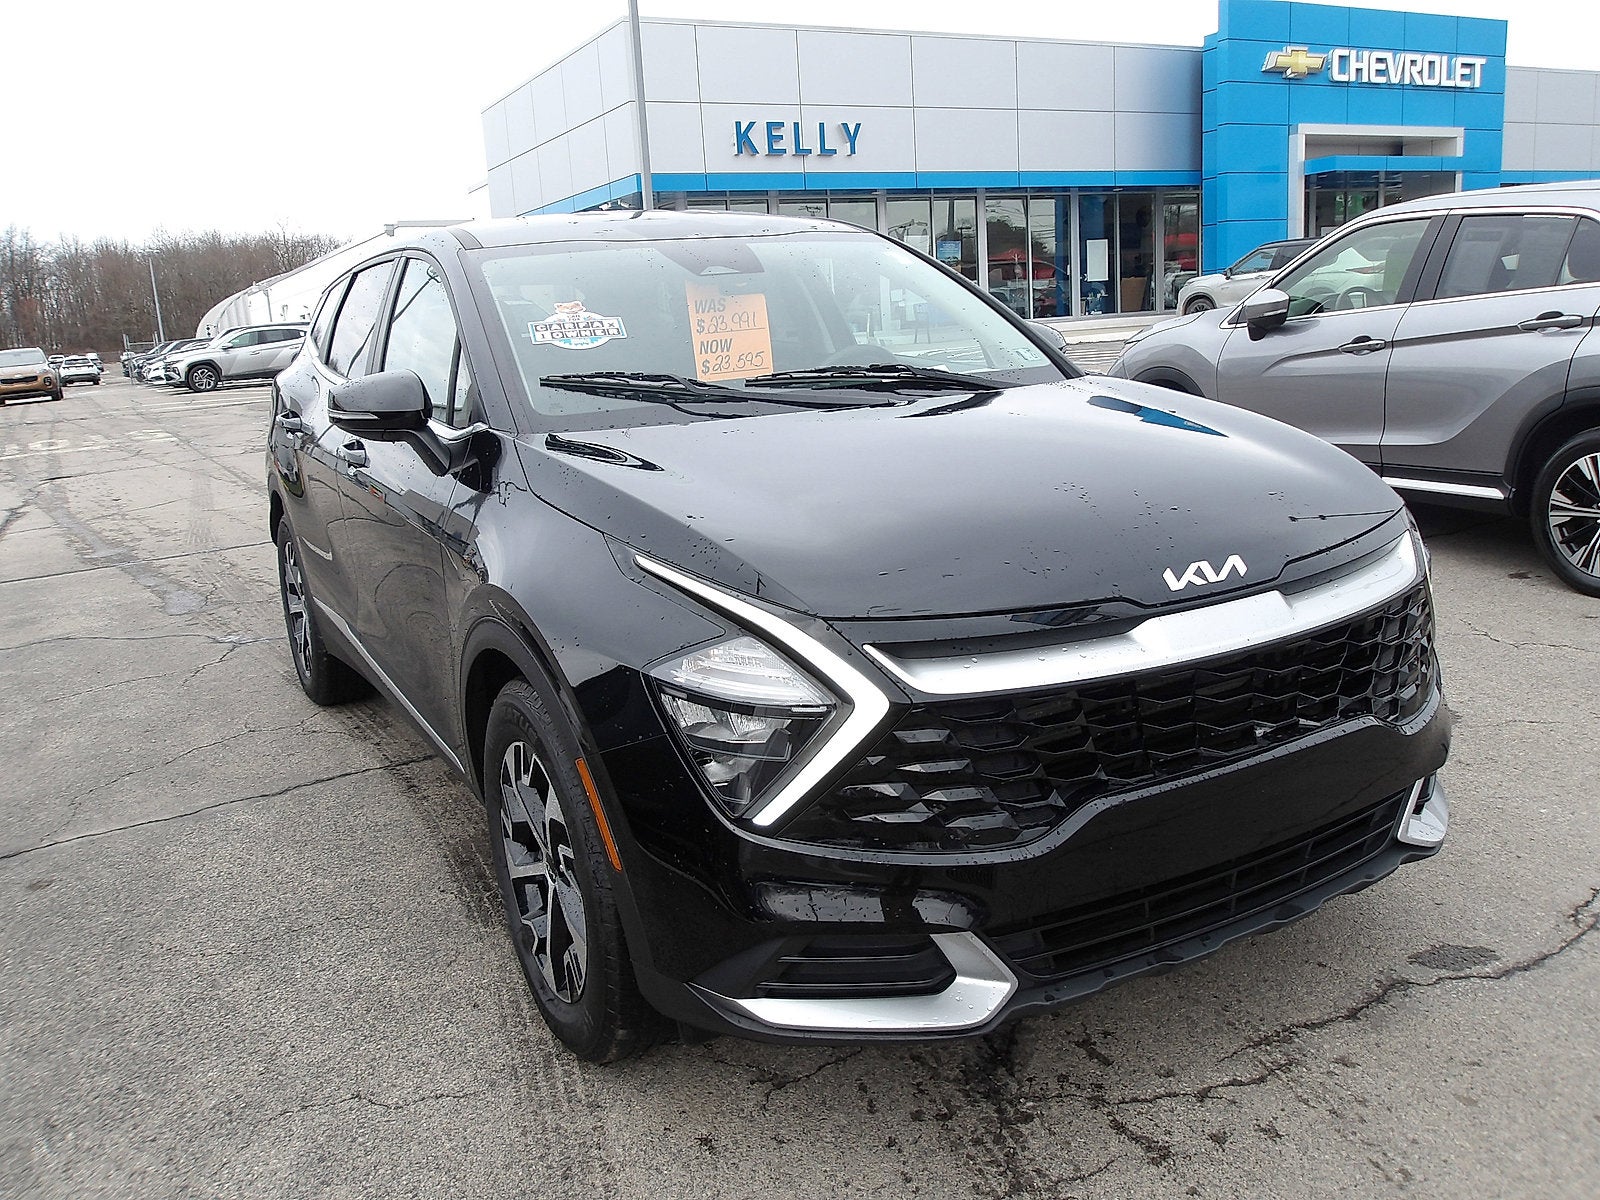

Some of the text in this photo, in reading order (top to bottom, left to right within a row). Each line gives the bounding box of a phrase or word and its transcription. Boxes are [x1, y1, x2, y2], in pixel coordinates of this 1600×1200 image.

[1328, 48, 1487, 88] CHEVROLET
[734, 121, 862, 156] KELLY
[694, 298, 726, 314] WAS
[699, 338, 733, 355] NOW
[1162, 553, 1248, 592] KIA
